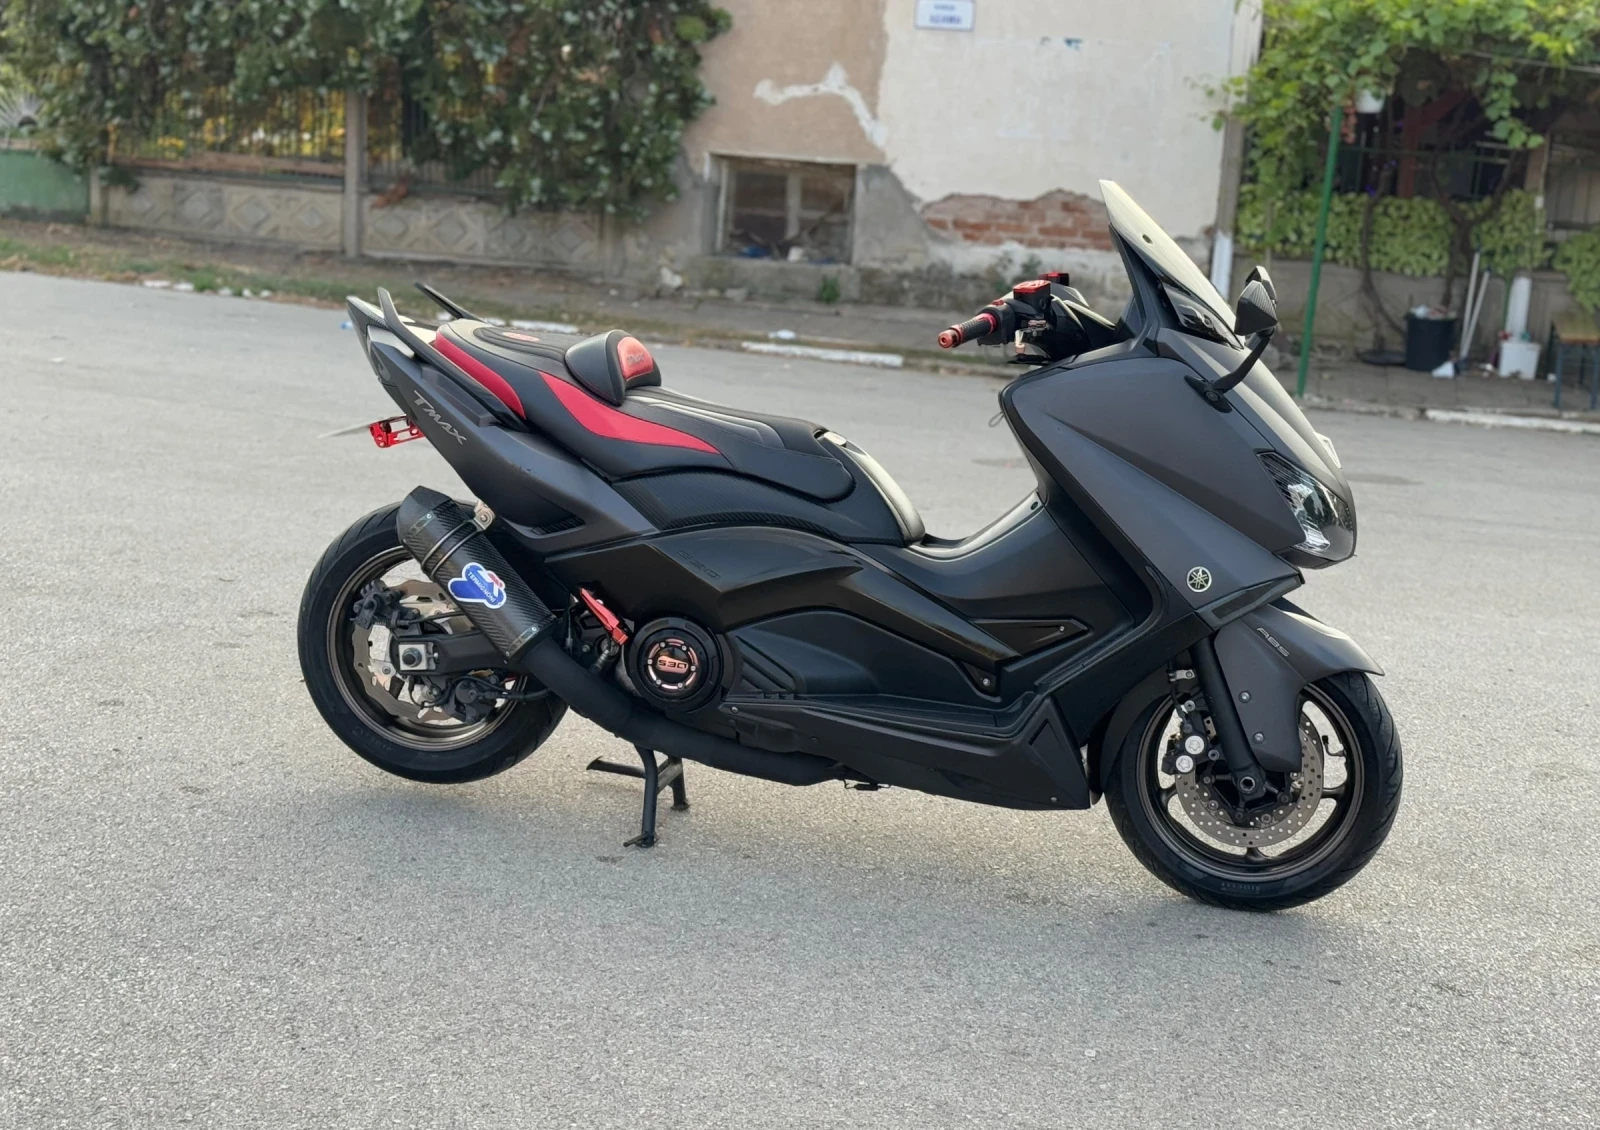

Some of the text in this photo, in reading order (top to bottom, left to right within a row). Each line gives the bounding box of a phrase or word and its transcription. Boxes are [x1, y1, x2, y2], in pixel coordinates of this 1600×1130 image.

[413, 389, 467, 446] TMAX
[467, 571, 497, 603] TERMIGNONI
[1256, 627, 1290, 657] ABS
